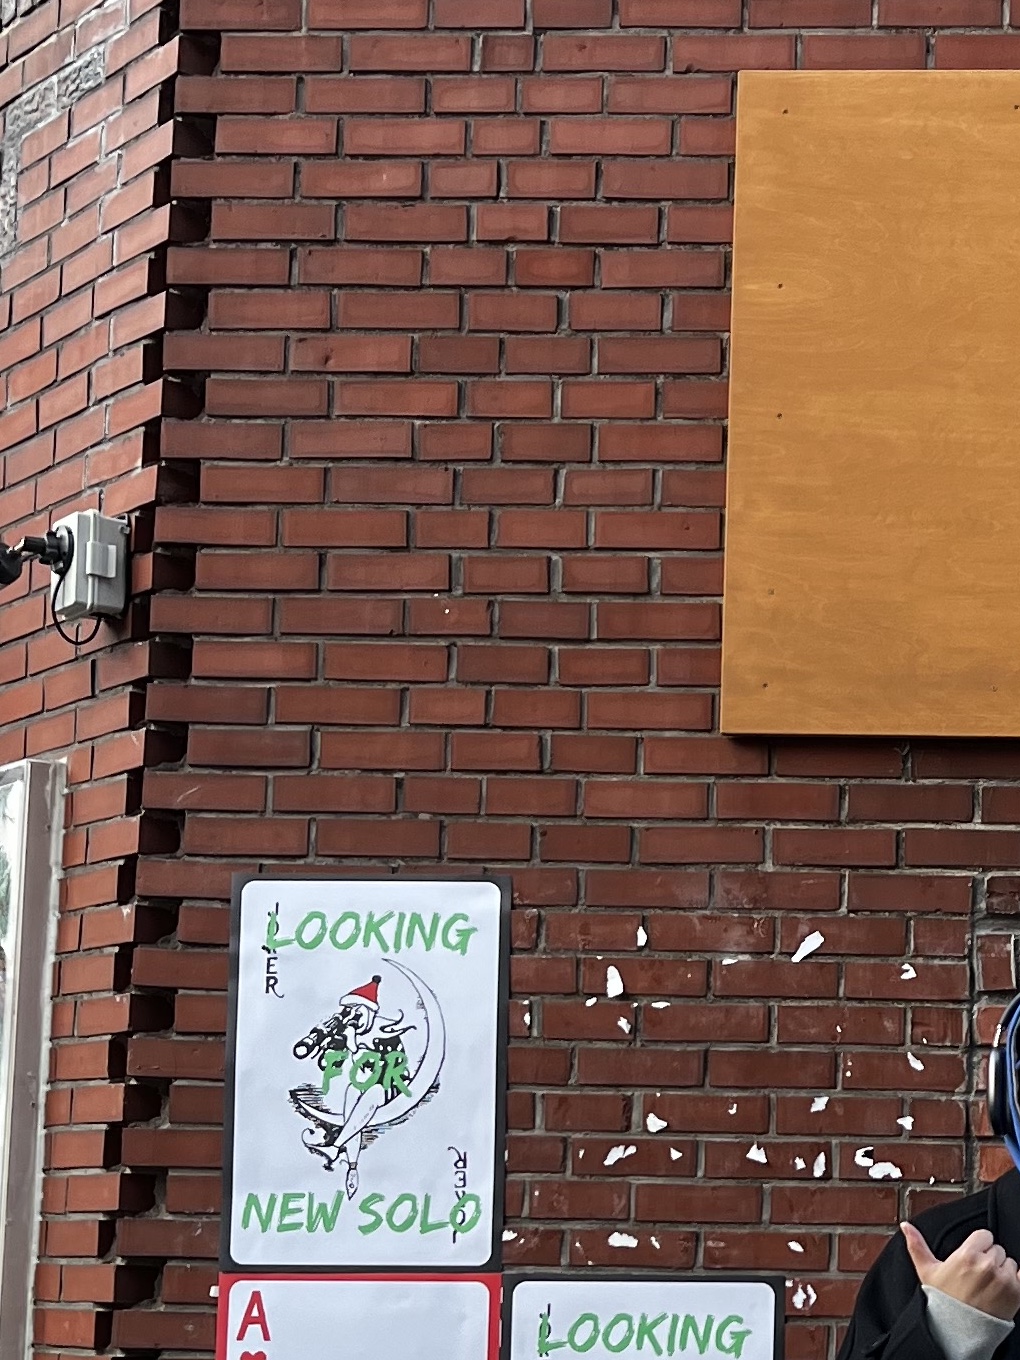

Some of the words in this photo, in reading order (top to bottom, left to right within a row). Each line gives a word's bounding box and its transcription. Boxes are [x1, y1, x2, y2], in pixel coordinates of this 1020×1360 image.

[265, 910, 478, 956] LOOKING
[321, 1050, 413, 1099] FOR
[241, 1189, 346, 1234] NEW
[357, 1191, 483, 1236] SOLO
[235, 1289, 272, 1342] A
[536, 1311, 753, 1360] LOOKING
